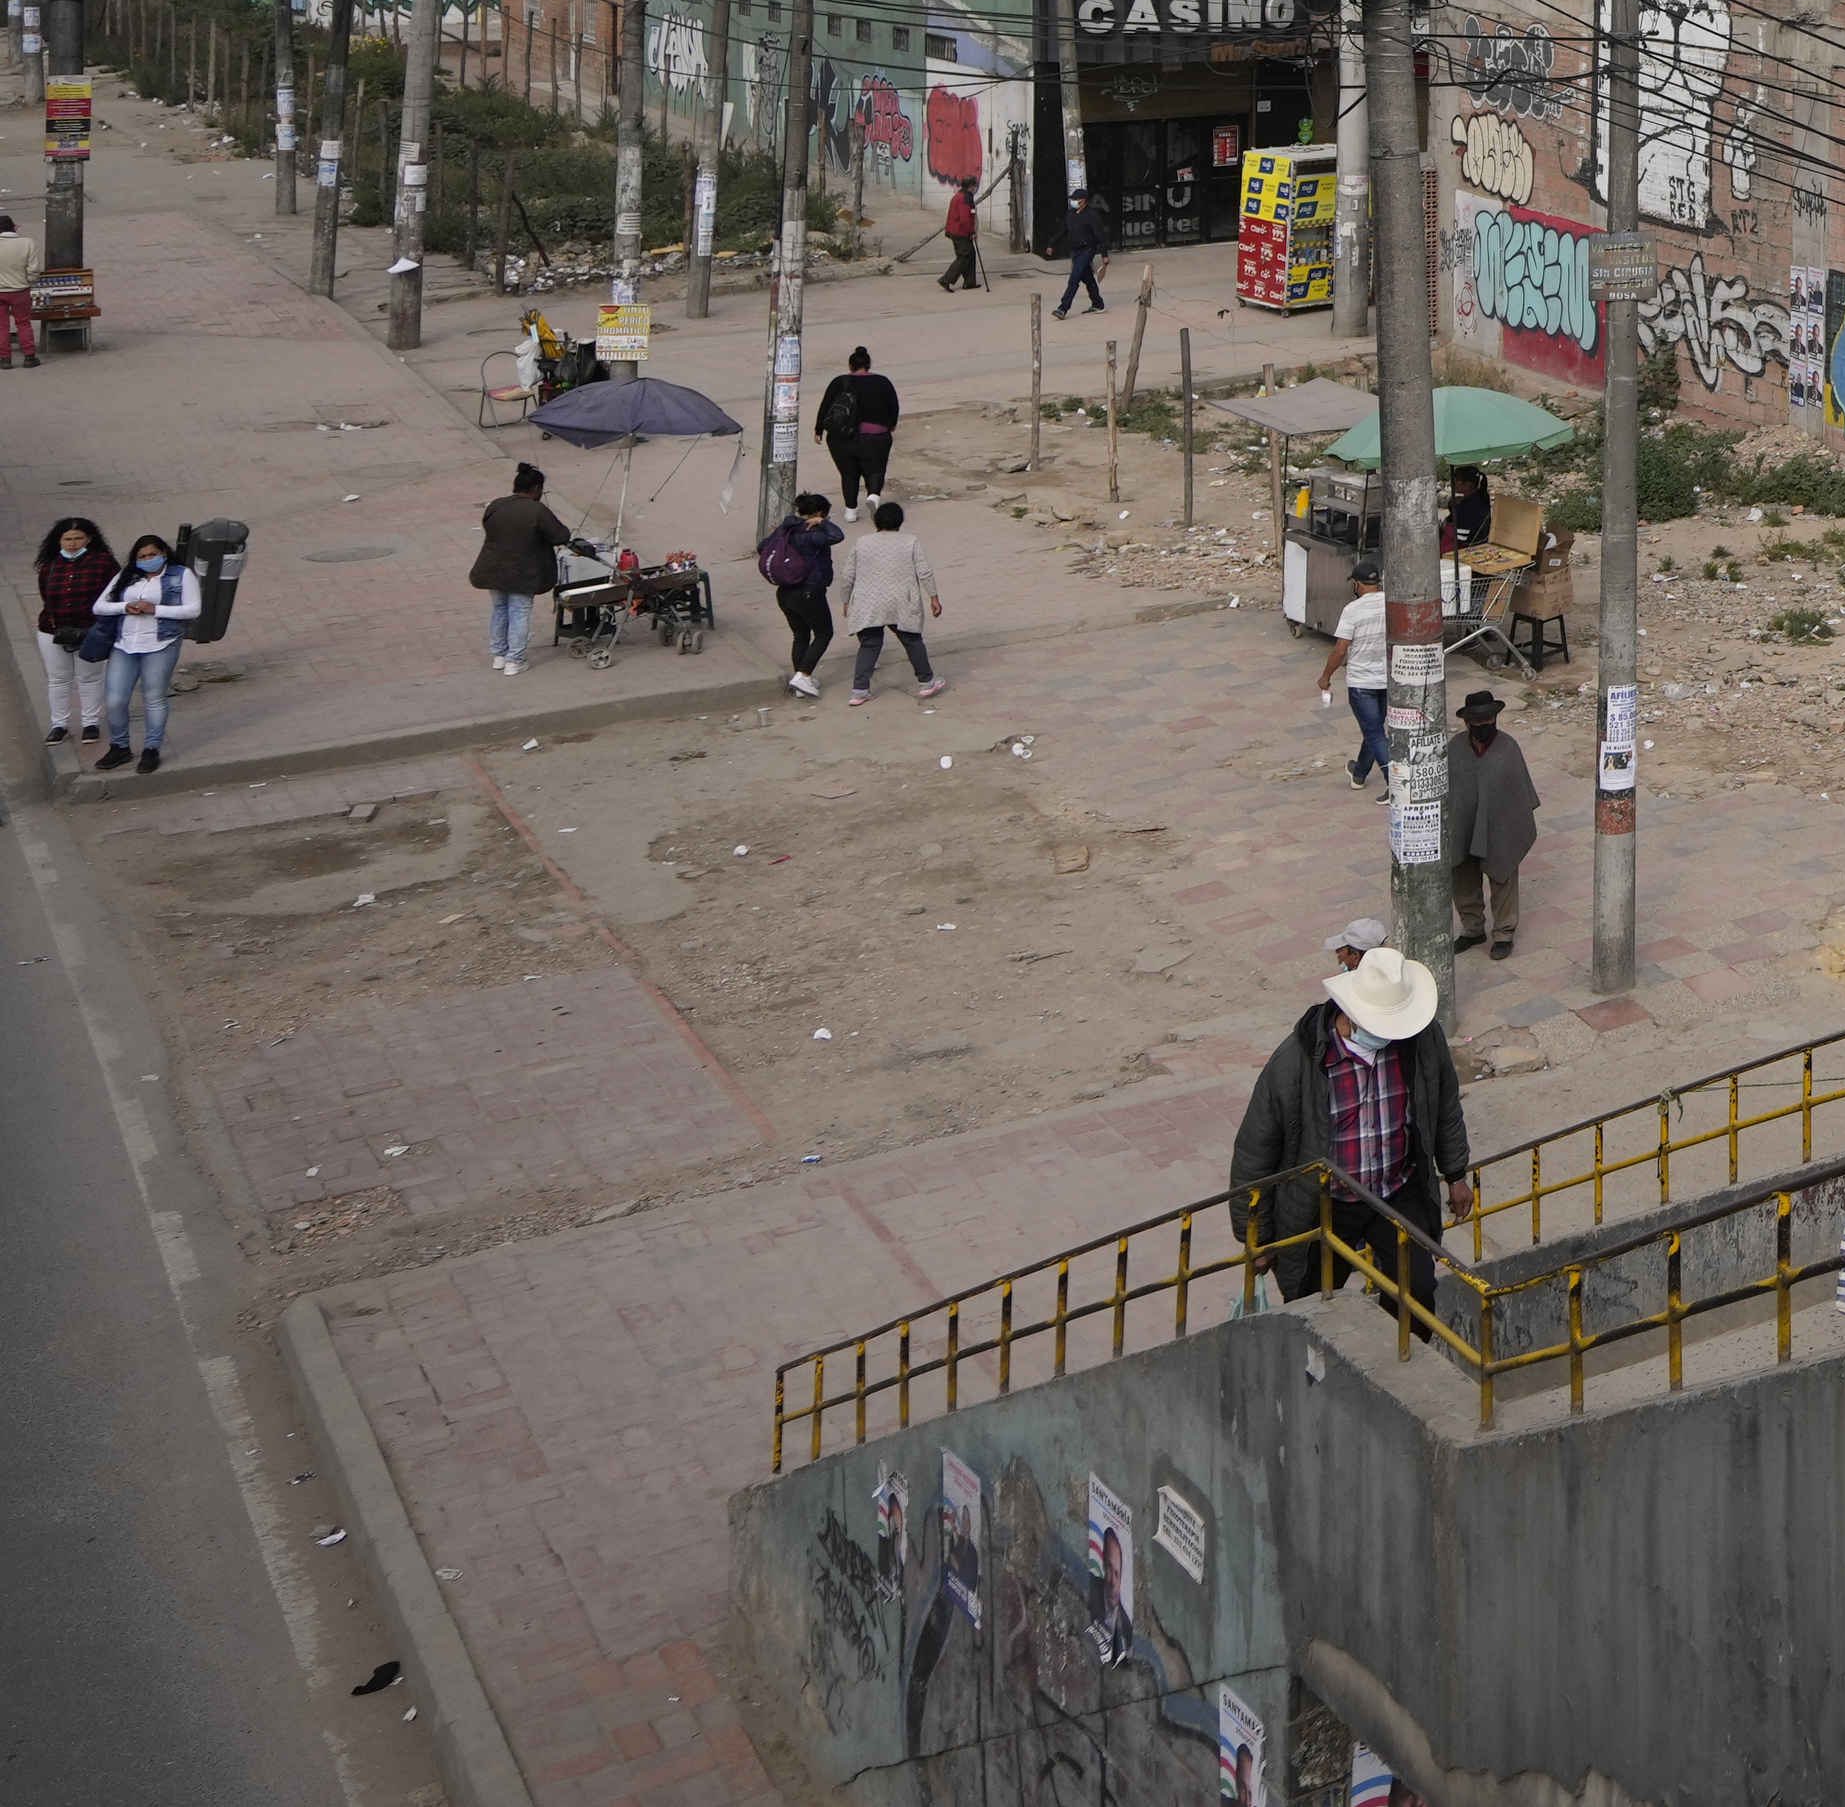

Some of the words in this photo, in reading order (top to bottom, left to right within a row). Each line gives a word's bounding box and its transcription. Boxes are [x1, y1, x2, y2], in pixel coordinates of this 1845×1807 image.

[1592, 268, 1610, 278] SIN
[1613, 266, 1654, 278] CIRUGIA
[1609, 292, 1637, 300] BOSA
[619, 316, 649, 326] PERICO
[596, 351, 648, 360] MINUTOS
[1403, 804, 1439, 812] APRENDA
